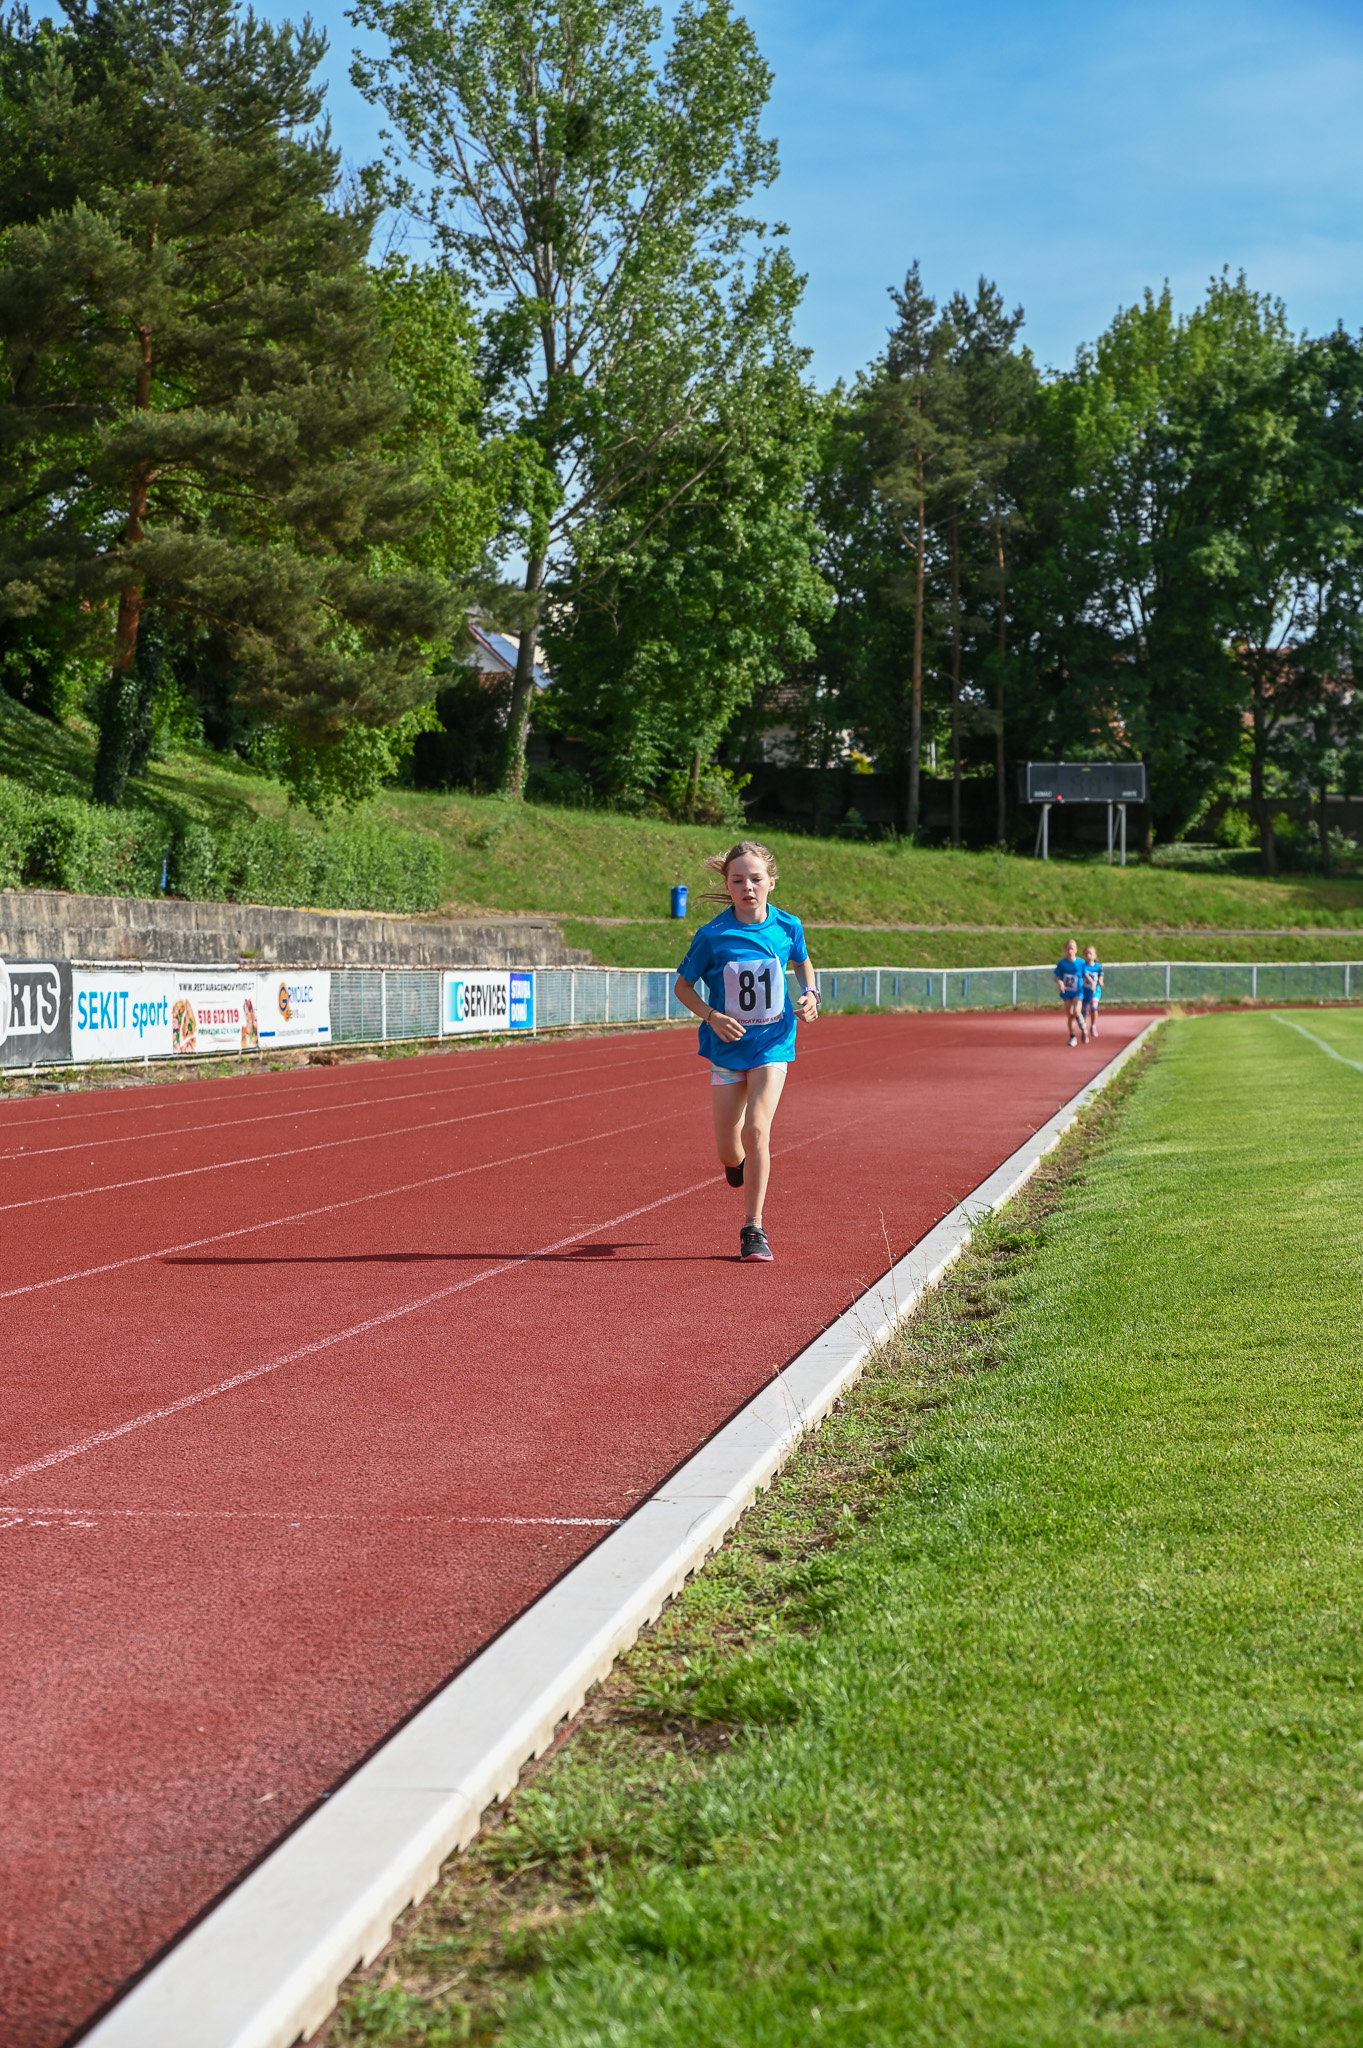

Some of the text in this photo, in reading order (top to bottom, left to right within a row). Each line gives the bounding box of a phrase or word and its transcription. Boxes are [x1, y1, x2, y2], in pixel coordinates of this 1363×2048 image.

[739, 968, 771, 1011] 81
[78, 991, 168, 1038] SEKIT sport
[198, 1009, 240, 1024] 518 612 119
